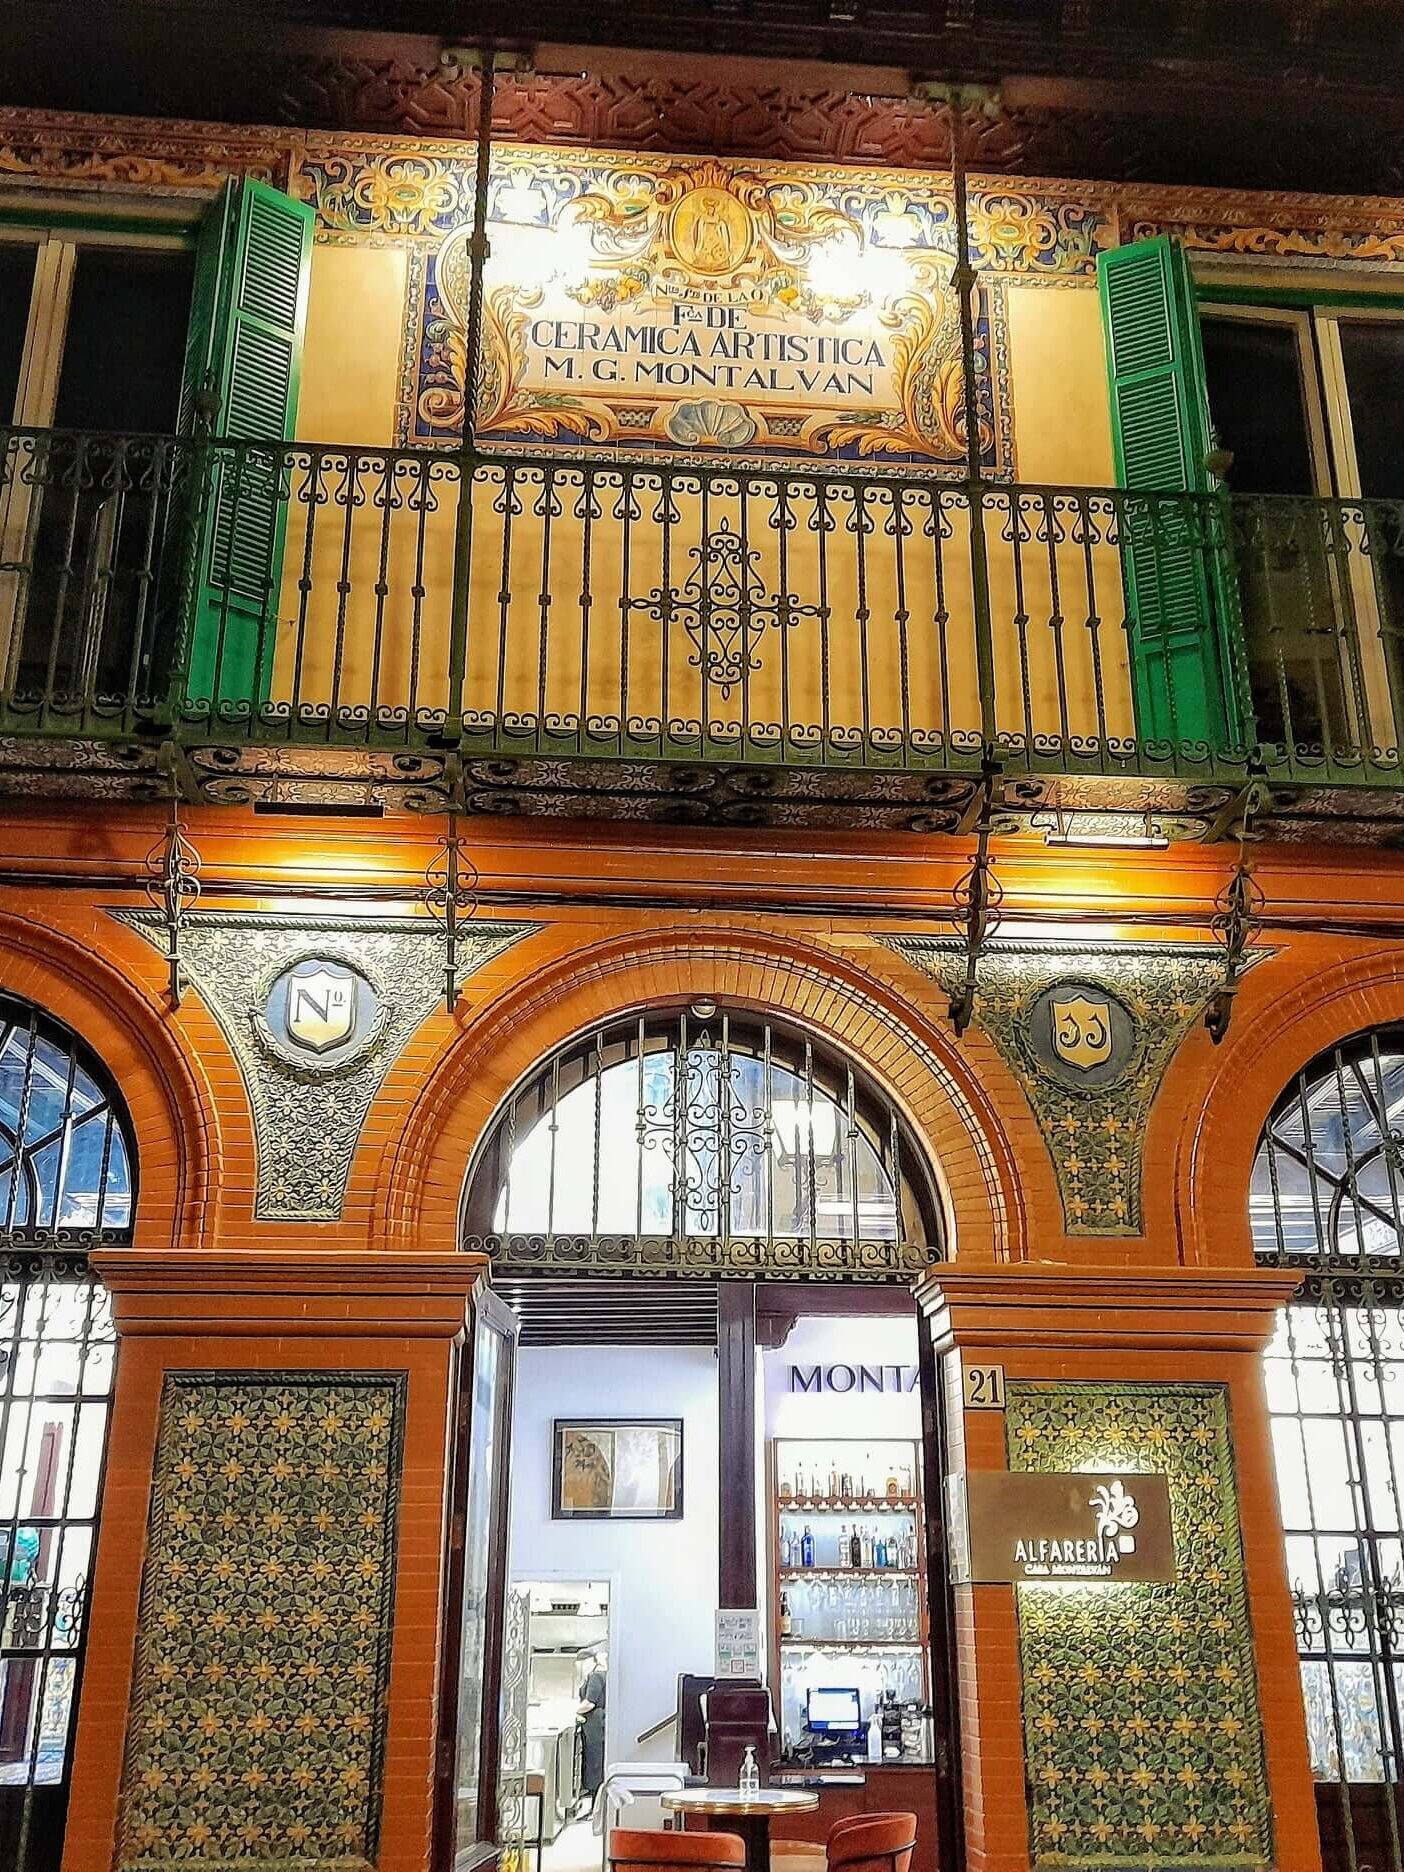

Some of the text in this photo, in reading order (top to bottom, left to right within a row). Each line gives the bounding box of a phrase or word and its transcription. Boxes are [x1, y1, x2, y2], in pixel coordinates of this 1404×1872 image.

[707, 306, 747, 329] DE
[531, 320, 886, 367] CERAMICA ARTISTICA
[544, 355, 874, 395] M. G. MONTALVAN
[969, 1369, 1001, 1403] 21
